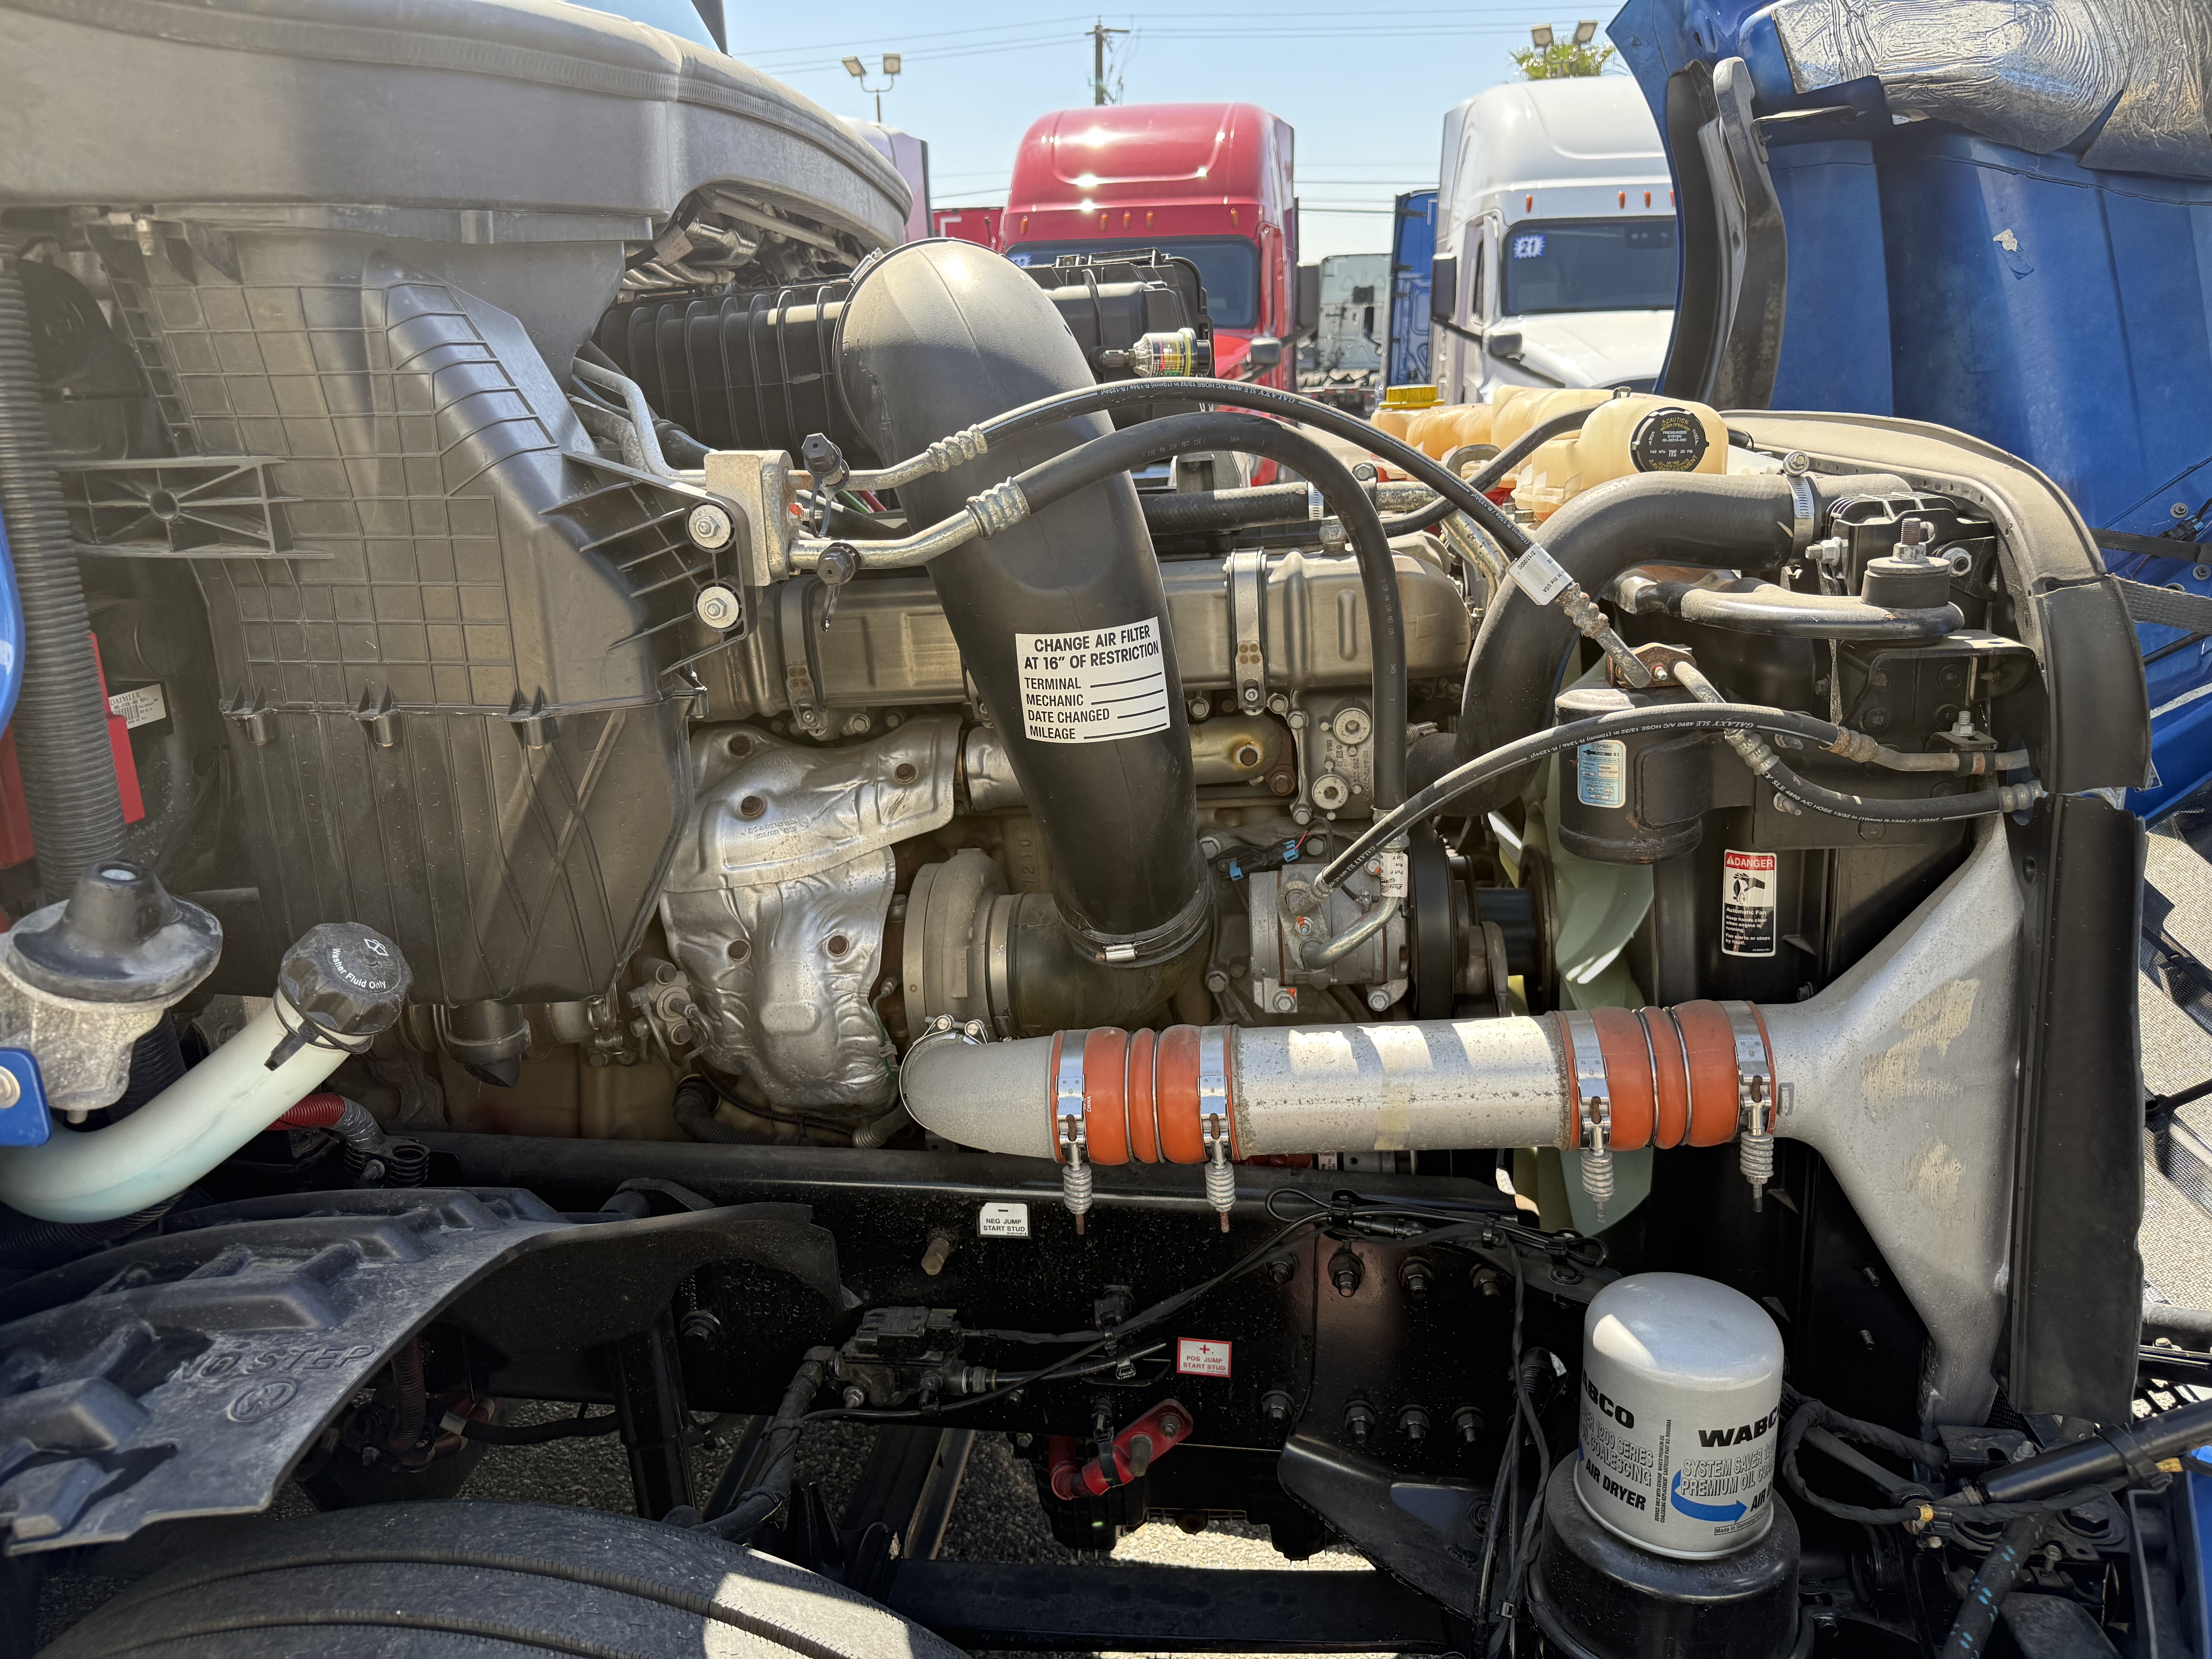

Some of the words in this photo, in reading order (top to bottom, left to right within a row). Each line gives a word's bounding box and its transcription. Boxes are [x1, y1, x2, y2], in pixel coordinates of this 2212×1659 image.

[1258, 390, 1295, 403] GALAXY
[1471, 493, 1492, 512] R-1234yf
[1496, 513, 1511, 529] R-134a
[1512, 528, 1530, 544] (10mm)
[1518, 551, 1536, 570] 2/17/2020
[1542, 583, 1552, 593] USA
[1034, 635, 1090, 653] CHANGE
[1095, 632, 1116, 648] AIR
[1121, 624, 1151, 644] FILTER
[1024, 656, 1039, 669] AT
[1070, 654, 1086, 668] OF
[1091, 641, 1159, 666] RESTRICTION
[1024, 677, 1081, 690] TERMINAL
[110, 692, 141, 706] DAIMLER
[1026, 694, 1084, 707] MECHANIC
[1028, 710, 1054, 723] DATE
[1057, 708, 1109, 723] CHANGED
[1030, 725, 1075, 739] MILEAGE
[1587, 732, 1611, 741] (10mm)
[1530, 746, 1558, 759] R-1234yf
[1563, 739, 1585, 747] R-134a
[1772, 780, 1786, 791] SLE
[1785, 791, 1800, 800] 4890
[1813, 804, 1833, 814] HOSE
[1354, 846, 1375, 866] GALAXY
[1735, 857, 1773, 868] DANGER
[332, 948, 347, 974] Washer
[345, 972, 367, 988] Fluid
[369, 981, 386, 989] Only
[242, 1345, 376, 1374] STEP
[1582, 1367, 1634, 1429] ABCO
[1698, 1397, 1781, 1447] WABC
[1596, 1420, 1615, 1449] 1200
[1617, 1436, 1653, 1468] SERIES
[1590, 1434, 1651, 1487] COALESCING
[1683, 1458, 1731, 1477] SYSTEM
[1734, 1448, 1762, 1474] SAVER
[1586, 1458, 1600, 1484] AIR
[1602, 1475, 1646, 1511] DRYER
[1681, 1476, 1738, 1496] PREMIUM
[1740, 1470, 1755, 1490] OIL
[1750, 1487, 1767, 1512] AIR
[1736, 1518, 1754, 1530] Germany
